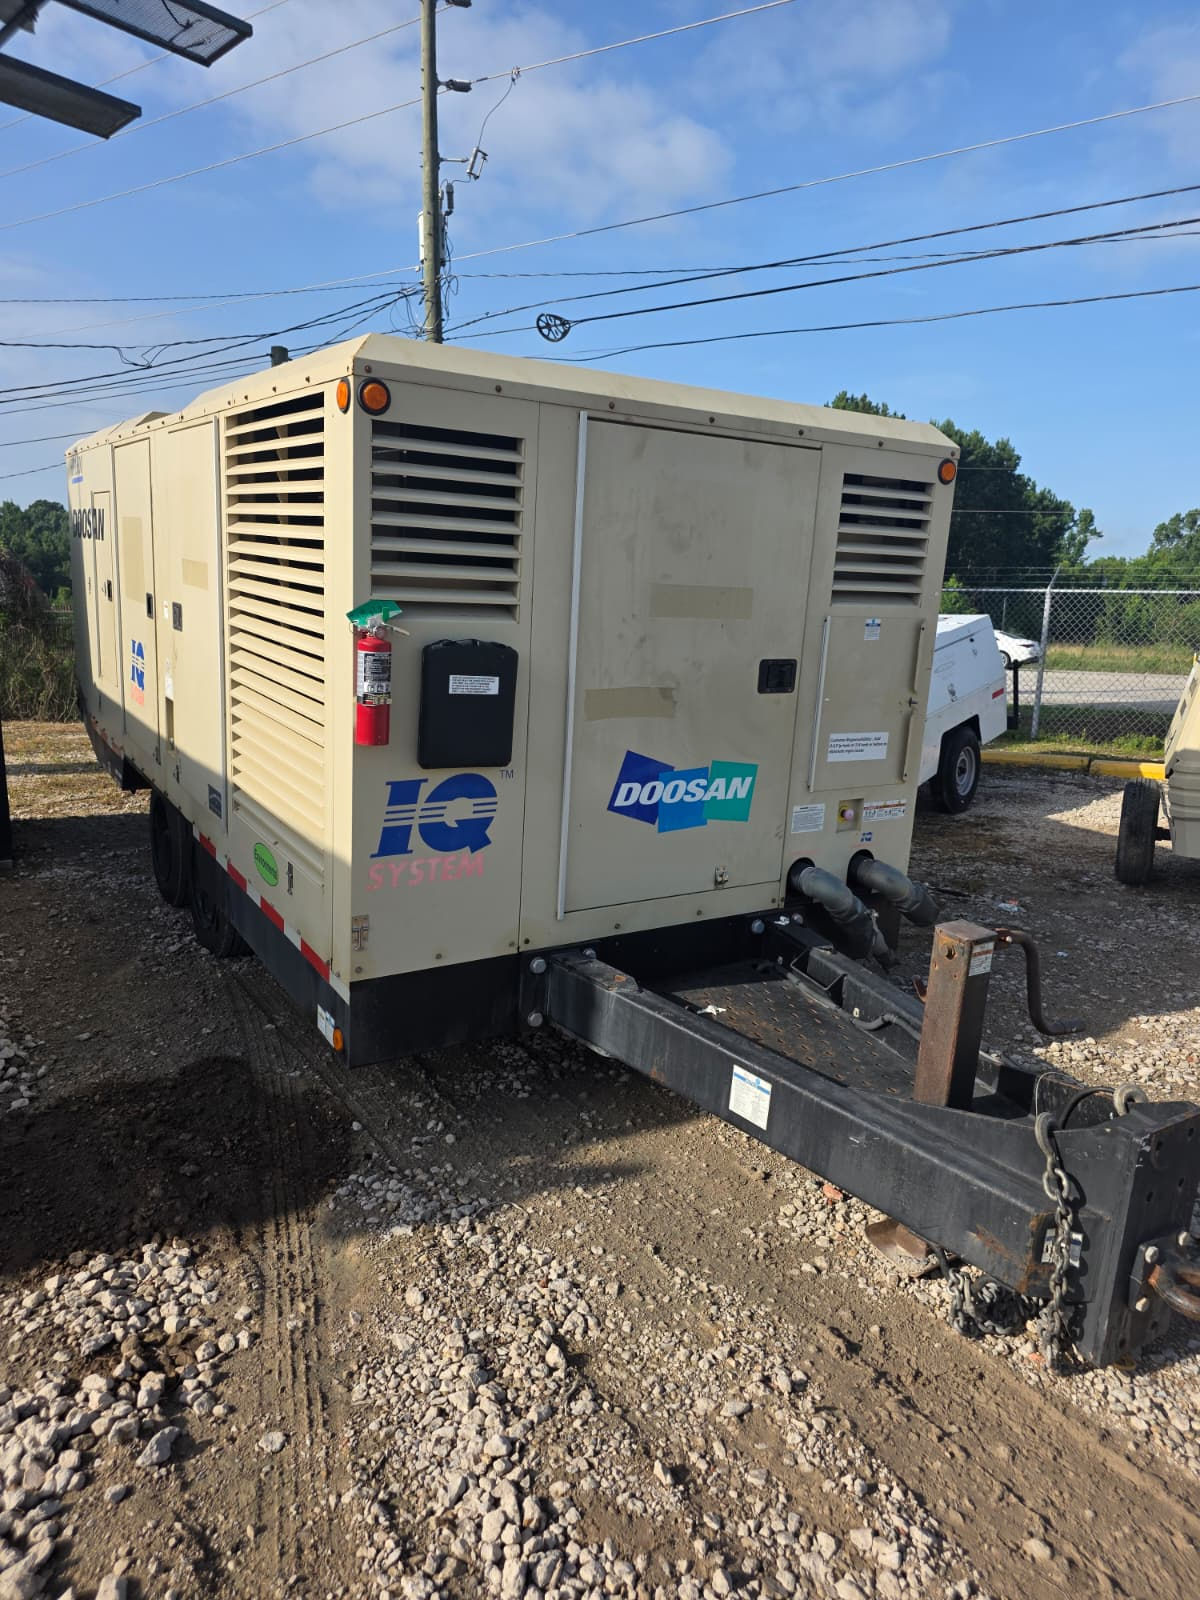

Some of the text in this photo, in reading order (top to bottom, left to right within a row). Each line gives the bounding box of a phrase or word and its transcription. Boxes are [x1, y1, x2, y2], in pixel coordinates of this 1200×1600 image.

[72, 508, 105, 541] DOOSAN
[613, 776, 752, 807] DOOSAN
[369, 772, 498, 859] IQ
[365, 853, 486, 892] SYSTEM
